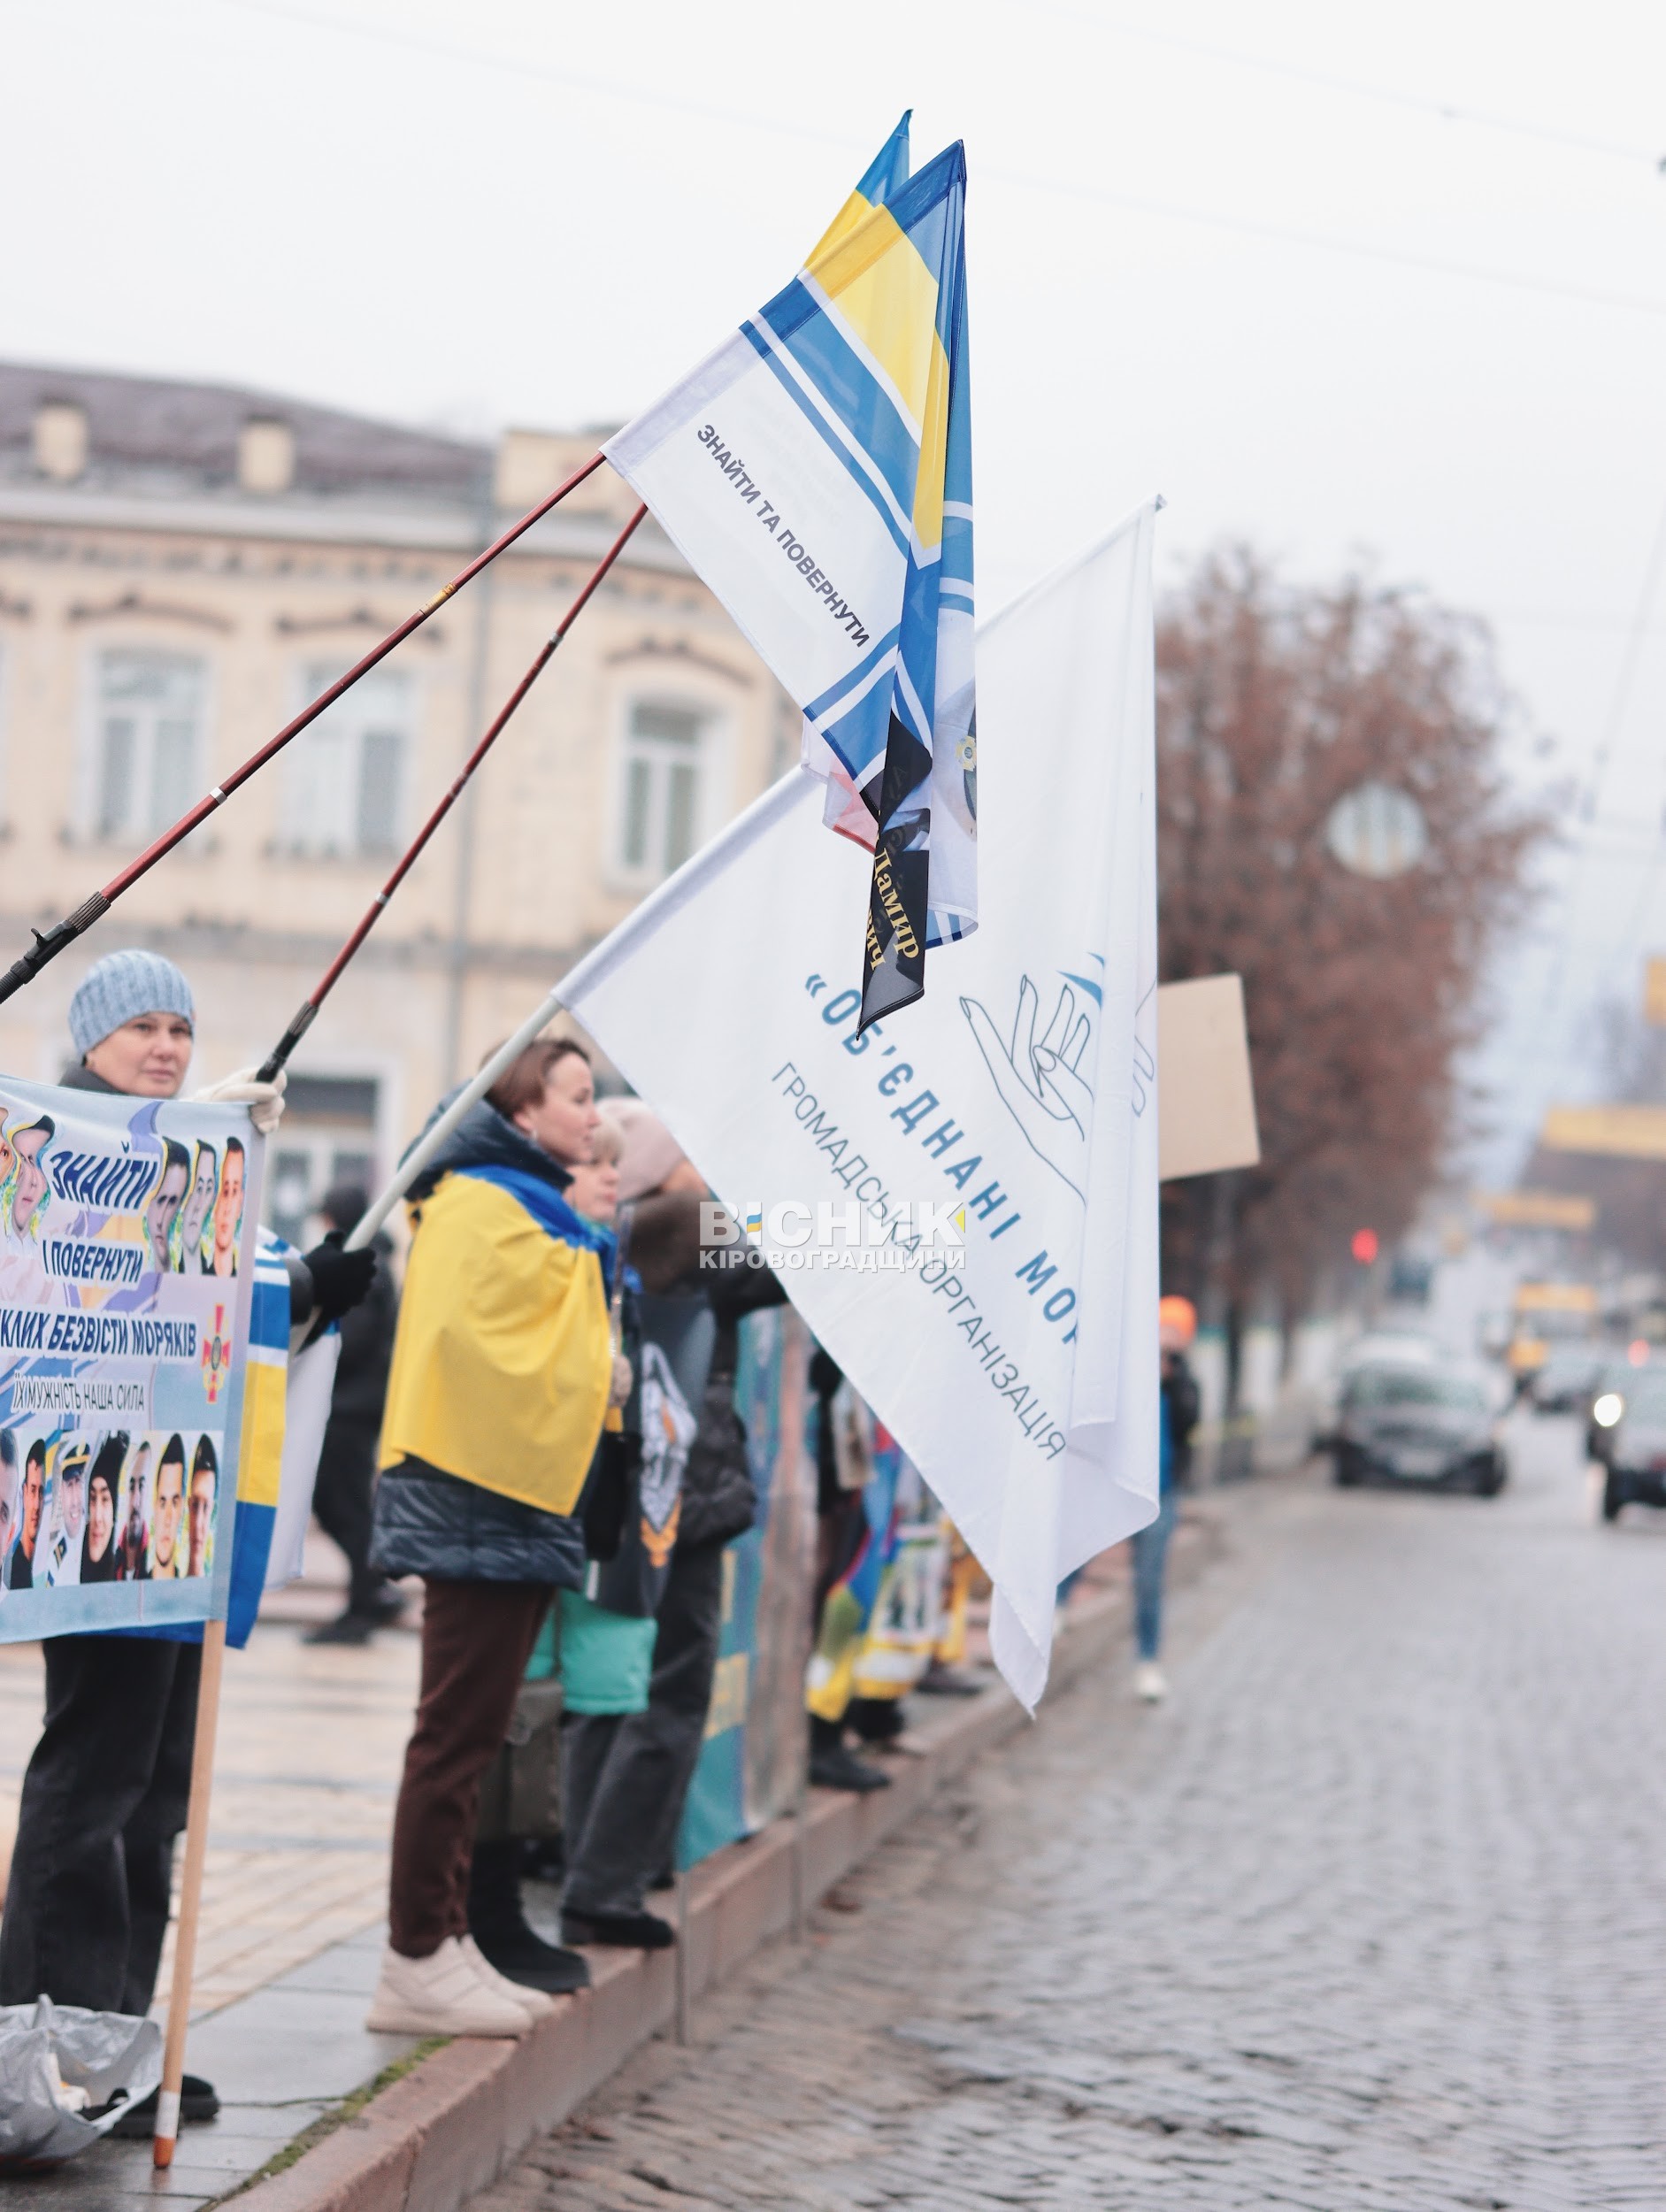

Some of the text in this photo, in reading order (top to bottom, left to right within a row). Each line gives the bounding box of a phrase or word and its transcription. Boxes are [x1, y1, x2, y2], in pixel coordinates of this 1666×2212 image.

[697, 425, 761, 504] ЗНАЙТИ
[756, 500, 781, 533] ТА
[776, 529, 870, 648] ПОВЕРНУТИ
[874, 847, 919, 959] Дамир
[50, 1141, 158, 1210] ЗНАЙТИ
[42, 1240, 143, 1283] І ПОВЕРНУТИ
[772, 1062, 1066, 1460] ГРОМАДСЬКА ОРГАНІЗАЦІЯ
[0, 1309, 196, 1357] КЛИХ БЕЗВІСТИ МОРЯКІВ
[12, 1372, 144, 1411] ЇХ МУЖНІСТЬ НАША СИЛА
